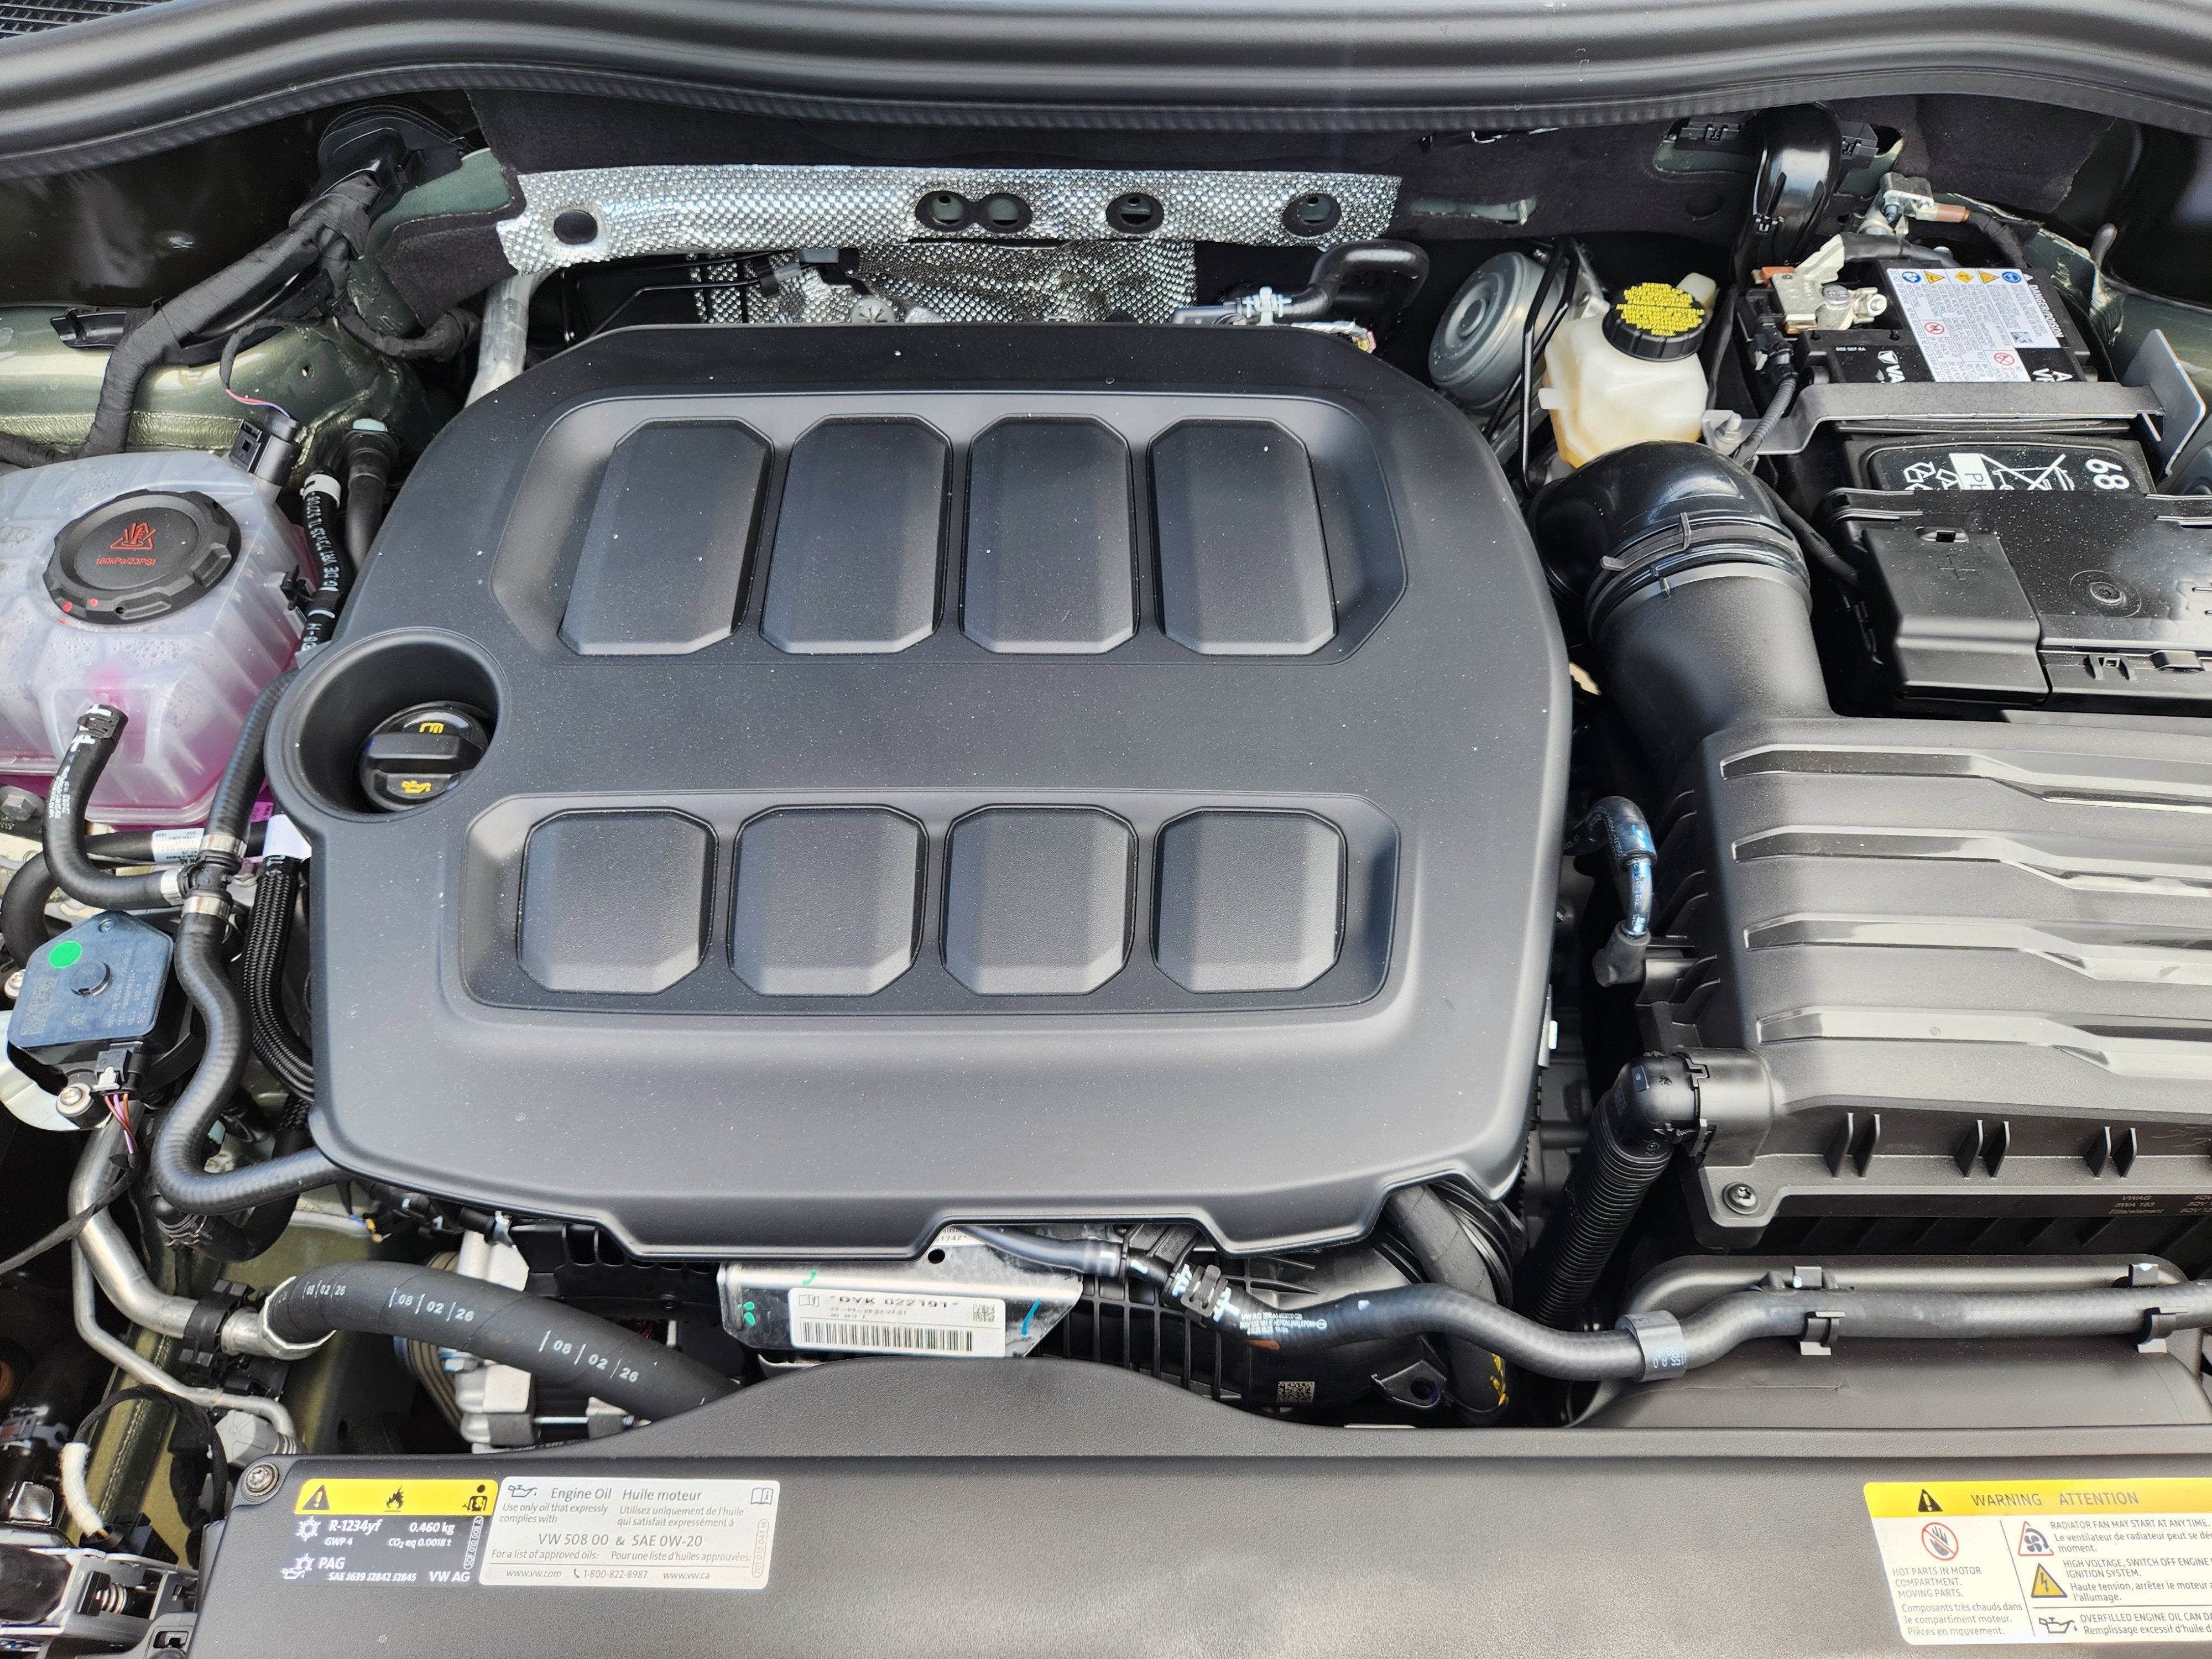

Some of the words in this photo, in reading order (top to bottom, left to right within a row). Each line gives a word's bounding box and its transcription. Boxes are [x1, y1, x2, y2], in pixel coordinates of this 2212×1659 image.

[2028, 284, 2064, 337] DANGER/POISON
[2085, 458, 2130, 490] 68
[95, 557, 157, 566] 160kPa/23PSI
[320, 1283, 330, 1295] 02
[335, 1284, 346, 1296] 26
[398, 1293, 413, 1306] 08
[426, 1301, 444, 1314] 02
[455, 1308, 475, 1323] 26
[552, 1340, 572, 1355] 08
[587, 1354, 608, 1371] 02
[619, 1366, 639, 1383] 26
[551, 1488, 592, 1502] Engine
[595, 1488, 612, 1500] Oil
[622, 1489, 654, 1501] Huile
[657, 1490, 702, 1501] moteur
[1970, 1493, 2042, 1506] WARNING
[2059, 1491, 2140, 1506] ATTENTION
[503, 1503, 518, 1511] Use
[520, 1503, 538, 1514] only
[539, 1503, 550, 1512] oil
[551, 1504, 568, 1512] that
[570, 1504, 609, 1515] expressly
[620, 1505, 651, 1515] Utilisez
[653, 1505, 704, 1517] uniquement
[706, 1506, 716, 1516] de
[718, 1506, 744, 1516] l'huile
[500, 1514, 536, 1525] complies
[617, 1518, 631, 1527] qui
[633, 1517, 666, 1526] satisfait
[668, 1518, 727, 1529] expressément
[729, 1519, 734, 1527] à
[2050, 1521, 2093, 1530] RADIATOR
[2093, 1520, 2110, 1528] FAN
[2111, 1520, 2128, 1528] MAY
[2131, 1520, 2155, 1528] START
[2188, 1519, 2210, 1527] TIME.
[328, 1519, 383, 1536] R-1234yf
[409, 1522, 441, 1533] 0.460
[442, 1522, 456, 1535] kg
[325, 1537, 346, 1546] GWP
[346, 1537, 353, 1546] 4
[405, 1540, 415, 1548] eq
[418, 1538, 445, 1547] 0.0018
[446, 1538, 452, 1547] t
[539, 1533, 562, 1545] VW
[564, 1533, 588, 1545] 508
[592, 1534, 609, 1545] 00
[615, 1536, 625, 1546] &
[632, 1536, 656, 1547] SAE
[660, 1536, 703, 1547] 0W-20
[2054, 1533, 2064, 1542] Le
[2067, 1532, 2112, 1541] ventilateur
[2115, 1532, 2125, 1541] de
[2127, 1532, 2164, 1540] radiateur
[2168, 1532, 2187, 1541] peut
[492, 1550, 506, 1558] For
[514, 1550, 527, 1558] list
[529, 1549, 539, 1558] of
[539, 1550, 580, 1561] approved
[581, 1550, 599, 1559] oils:
[611, 1551, 630, 1559] Pour
[649, 1552, 666, 1561] liste
[668, 1552, 700, 1561] d'huiles
[701, 1552, 752, 1563] approuvées:
[319, 1557, 346, 1569] PAG
[2085, 1559, 2126, 1568] VOLTAGE,
[2126, 1558, 2158, 1567] SWITCH
[429, 1571, 448, 1582] VW
[452, 1572, 470, 1582] AG
[583, 1569, 648, 1579] 1-800-822-8987
[663, 1571, 709, 1579] www.vw.ca
[1912, 1567, 1938, 1575] PARTS
[2066, 1569, 2104, 1578] IGNITION
[2107, 1569, 2141, 1577] SYSTEM.
[327, 1573, 345, 1581] SAE
[345, 1572, 366, 1581] J639
[367, 1572, 392, 1582] J2842
[392, 1573, 417, 1582] J2845
[1895, 1578, 1962, 1587] COMPARTMENT.
[2070, 1582, 2096, 1591] Haute
[2099, 1582, 2134, 1592] tension,
[2136, 1581, 2164, 1590] arrêter
[2166, 1581, 2174, 1589] le
[1898, 1589, 1933, 1598] MOVING
[1934, 1589, 1964, 1597] PARTS.
[2073, 1593, 2121, 1603] l'allumage.
[1902, 1604, 1953, 1614] Composants
[1954, 1603, 1970, 1611] très
[1973, 1603, 2001, 1611] chauds
[1905, 1615, 1912, 1624] le
[1915, 1615, 1977, 1625] compartiment
[2080, 1614, 2132, 1623] OVERFILLED
[2134, 1613, 2166, 1622] ENGINE
[2184, 1613, 2203, 1621] CAN
[1908, 1627, 1935, 1636] Pièces
[2084, 1625, 2137, 1635] Remplissage
[2140, 1625, 2172, 1633] excessif
[2176, 1624, 2203, 1633] d'huile
